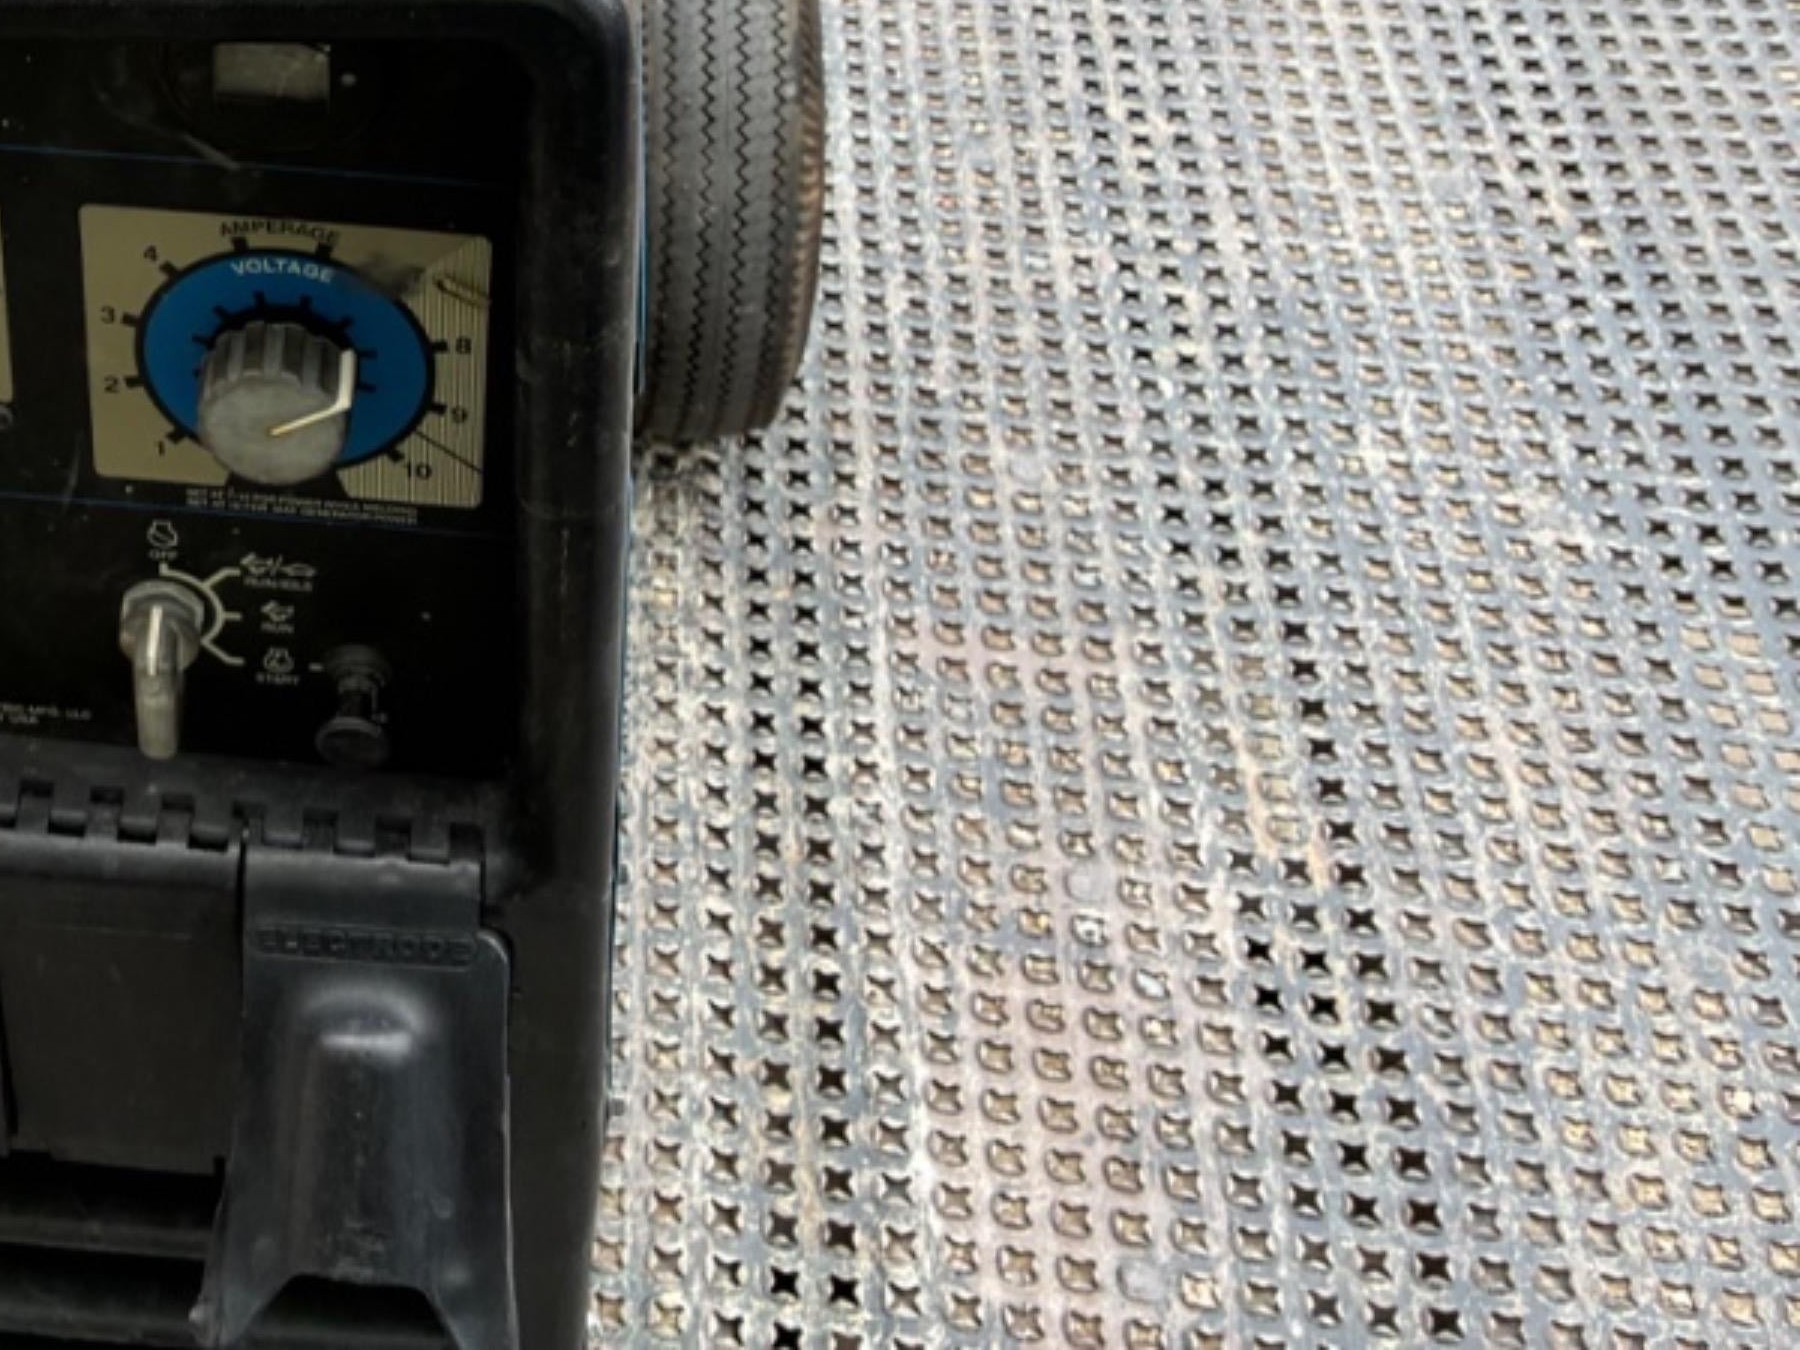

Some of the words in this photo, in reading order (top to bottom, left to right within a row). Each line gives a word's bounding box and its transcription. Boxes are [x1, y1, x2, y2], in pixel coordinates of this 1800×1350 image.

[220, 219, 341, 245] AMPERAGE
[142, 245, 158, 263] 4
[229, 257, 335, 284] VOLTAGE
[99, 306, 116, 324] 3
[457, 338, 473, 356] 8
[103, 375, 120, 394] 2
[451, 407, 468, 425] 9
[156, 440, 165, 457] 1
[402, 460, 432, 480] 10
